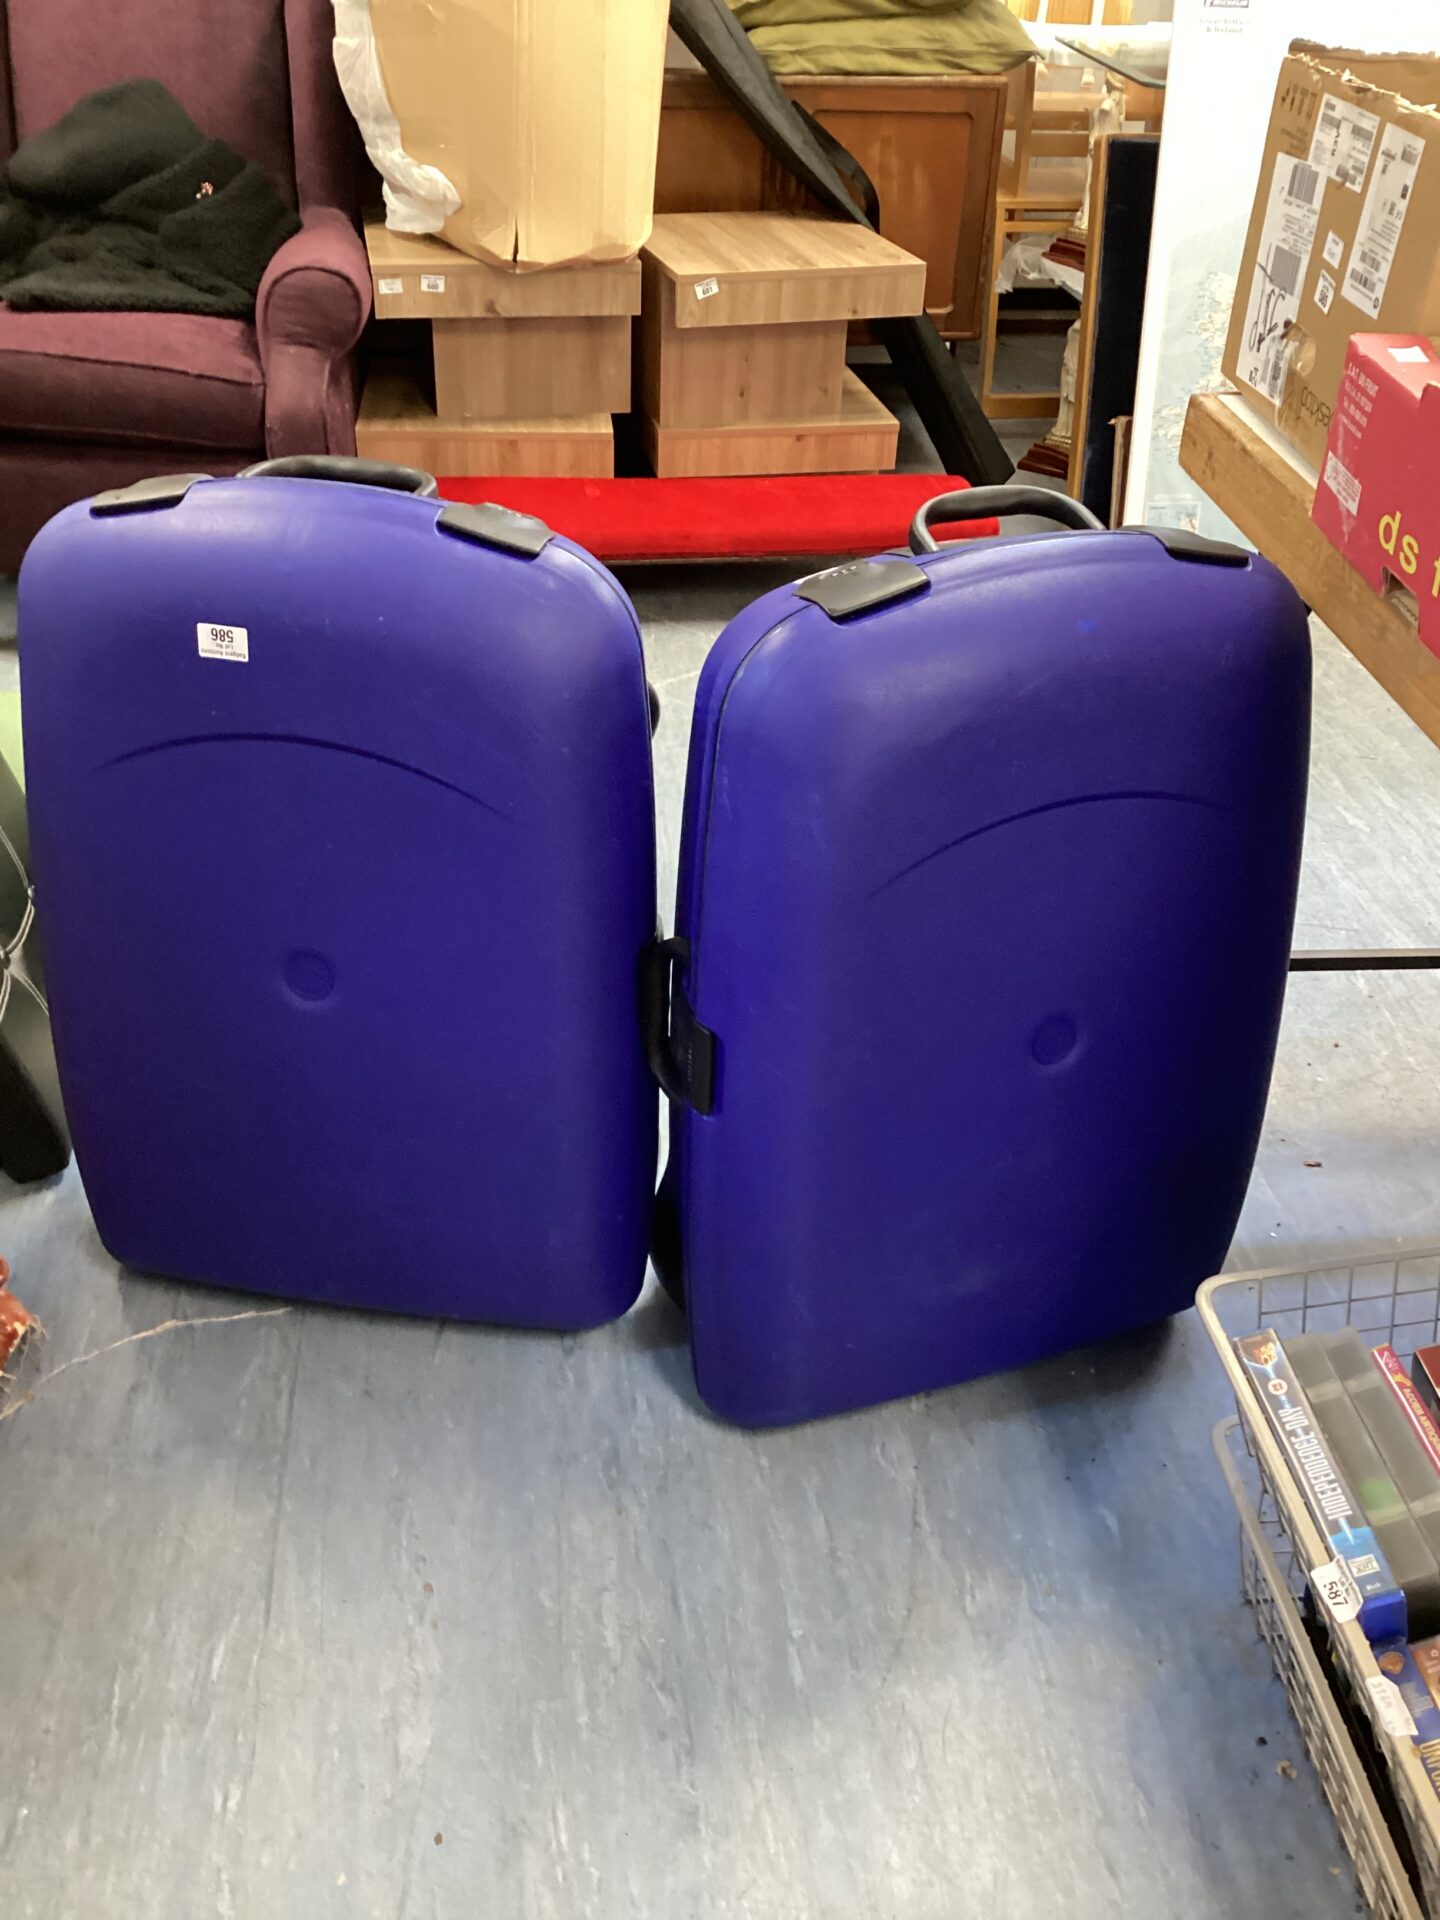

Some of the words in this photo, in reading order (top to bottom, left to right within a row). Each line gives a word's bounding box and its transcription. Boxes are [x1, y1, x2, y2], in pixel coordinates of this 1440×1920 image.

[1378, 510, 1420, 575] ds
[210, 627, 234, 643] 586
[1277, 1406, 1310, 1431] DAY
[1419, 1413, 1440, 1456] ANTIQU
[1290, 1431, 1354, 1521] INDEPENDENCE
[1323, 1581, 1349, 1606] 587
